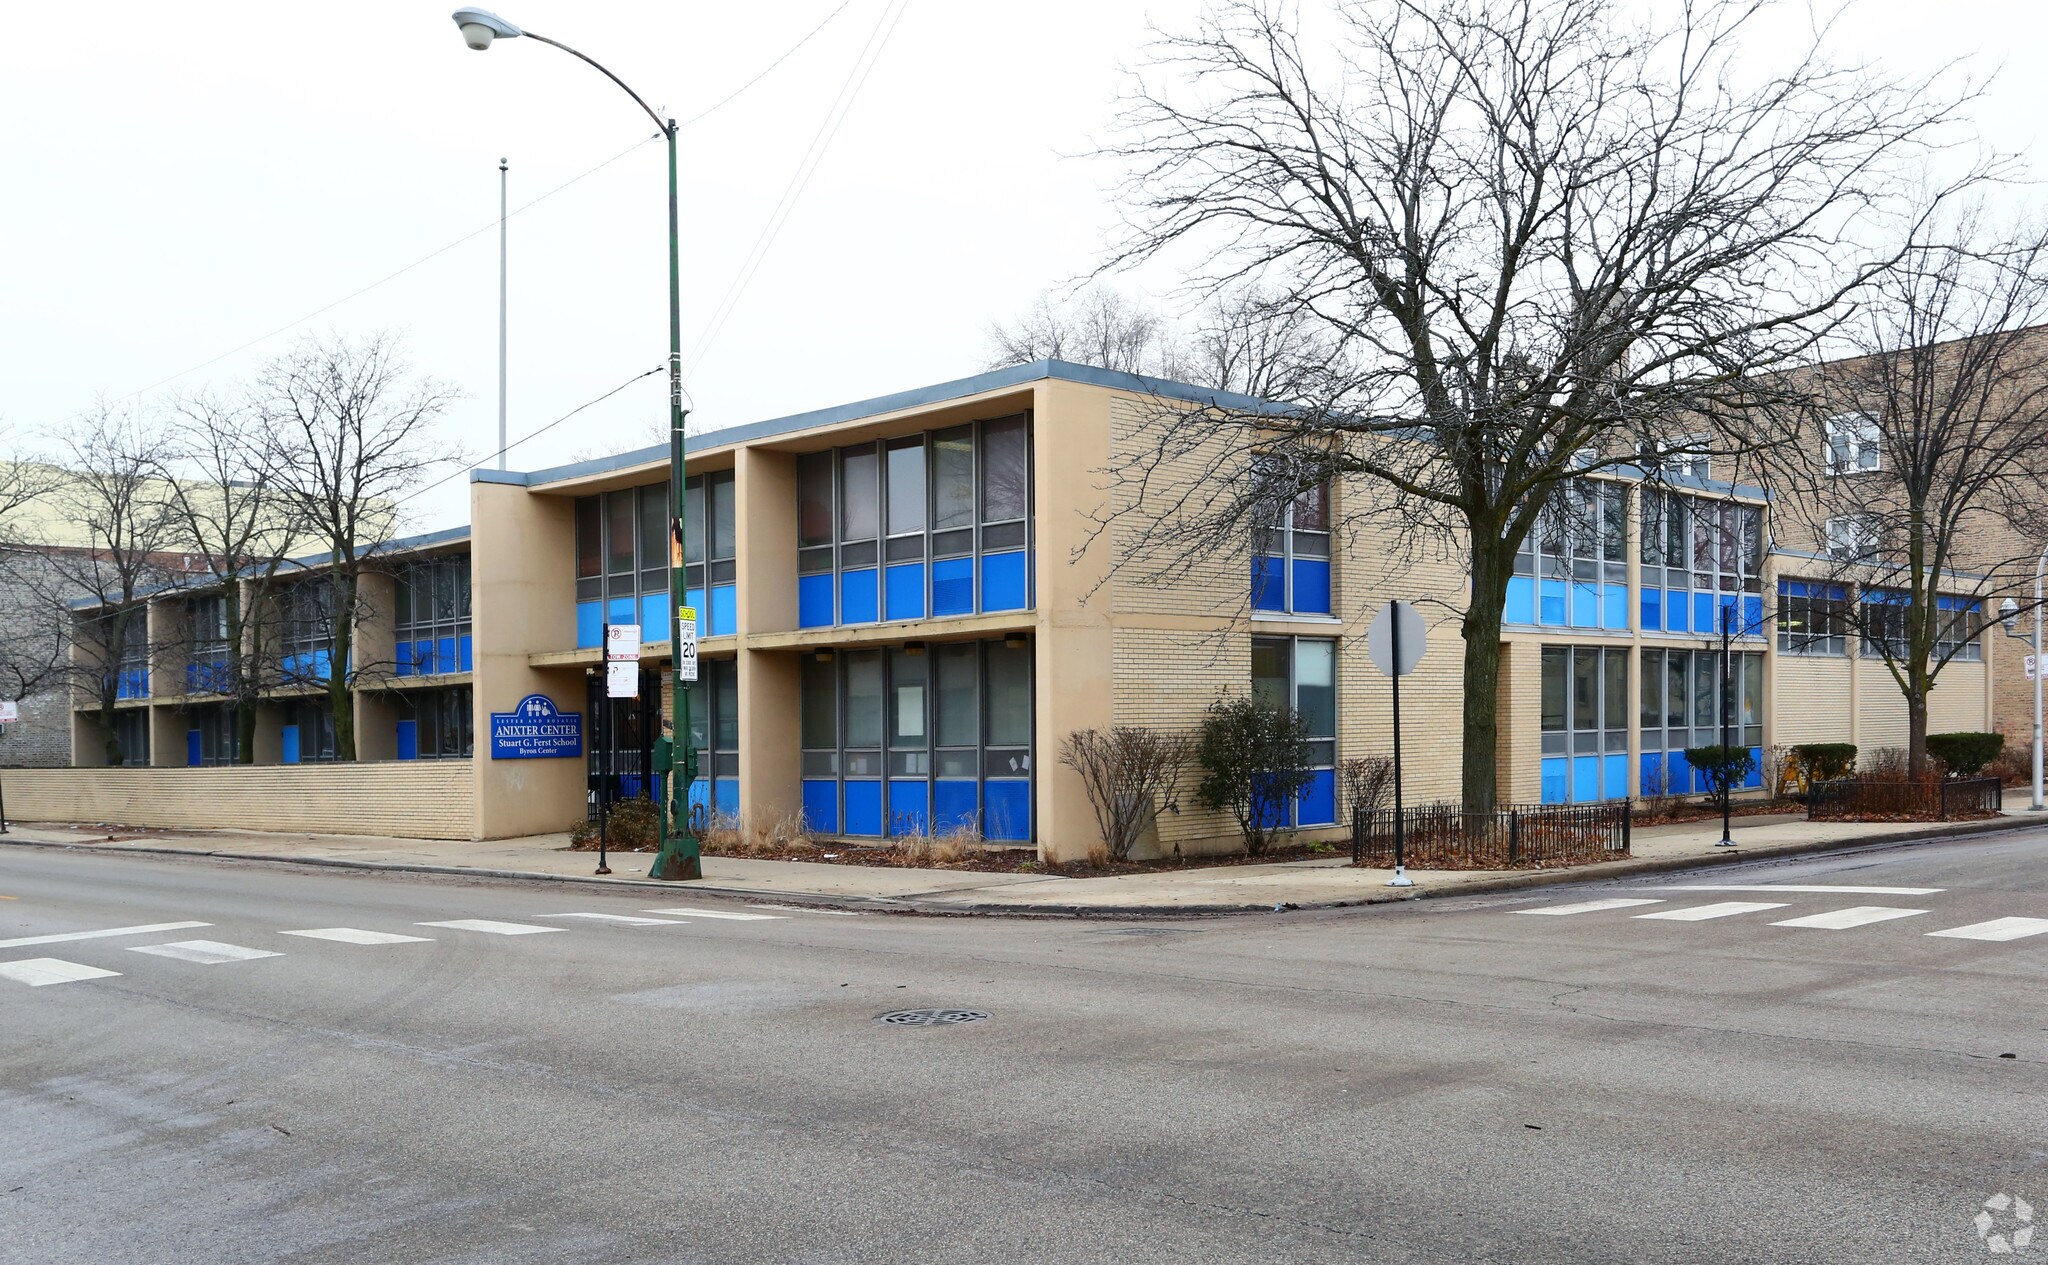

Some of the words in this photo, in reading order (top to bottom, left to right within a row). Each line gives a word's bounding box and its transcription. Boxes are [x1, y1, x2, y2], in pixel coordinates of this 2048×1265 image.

[680, 609, 695, 619] SCHOOL
[681, 622, 695, 631] SPEED
[683, 632, 694, 640] LIMIT
[683, 642, 695, 659] 20
[496, 726, 538, 736] ANIXTER
[540, 725, 577, 735] CENTER
[498, 739, 521, 747] Stuart
[523, 739, 532, 747] G.
[533, 738, 551, 747] Ferst
[552, 738, 577, 746] School
[519, 748, 537, 756] Byron
